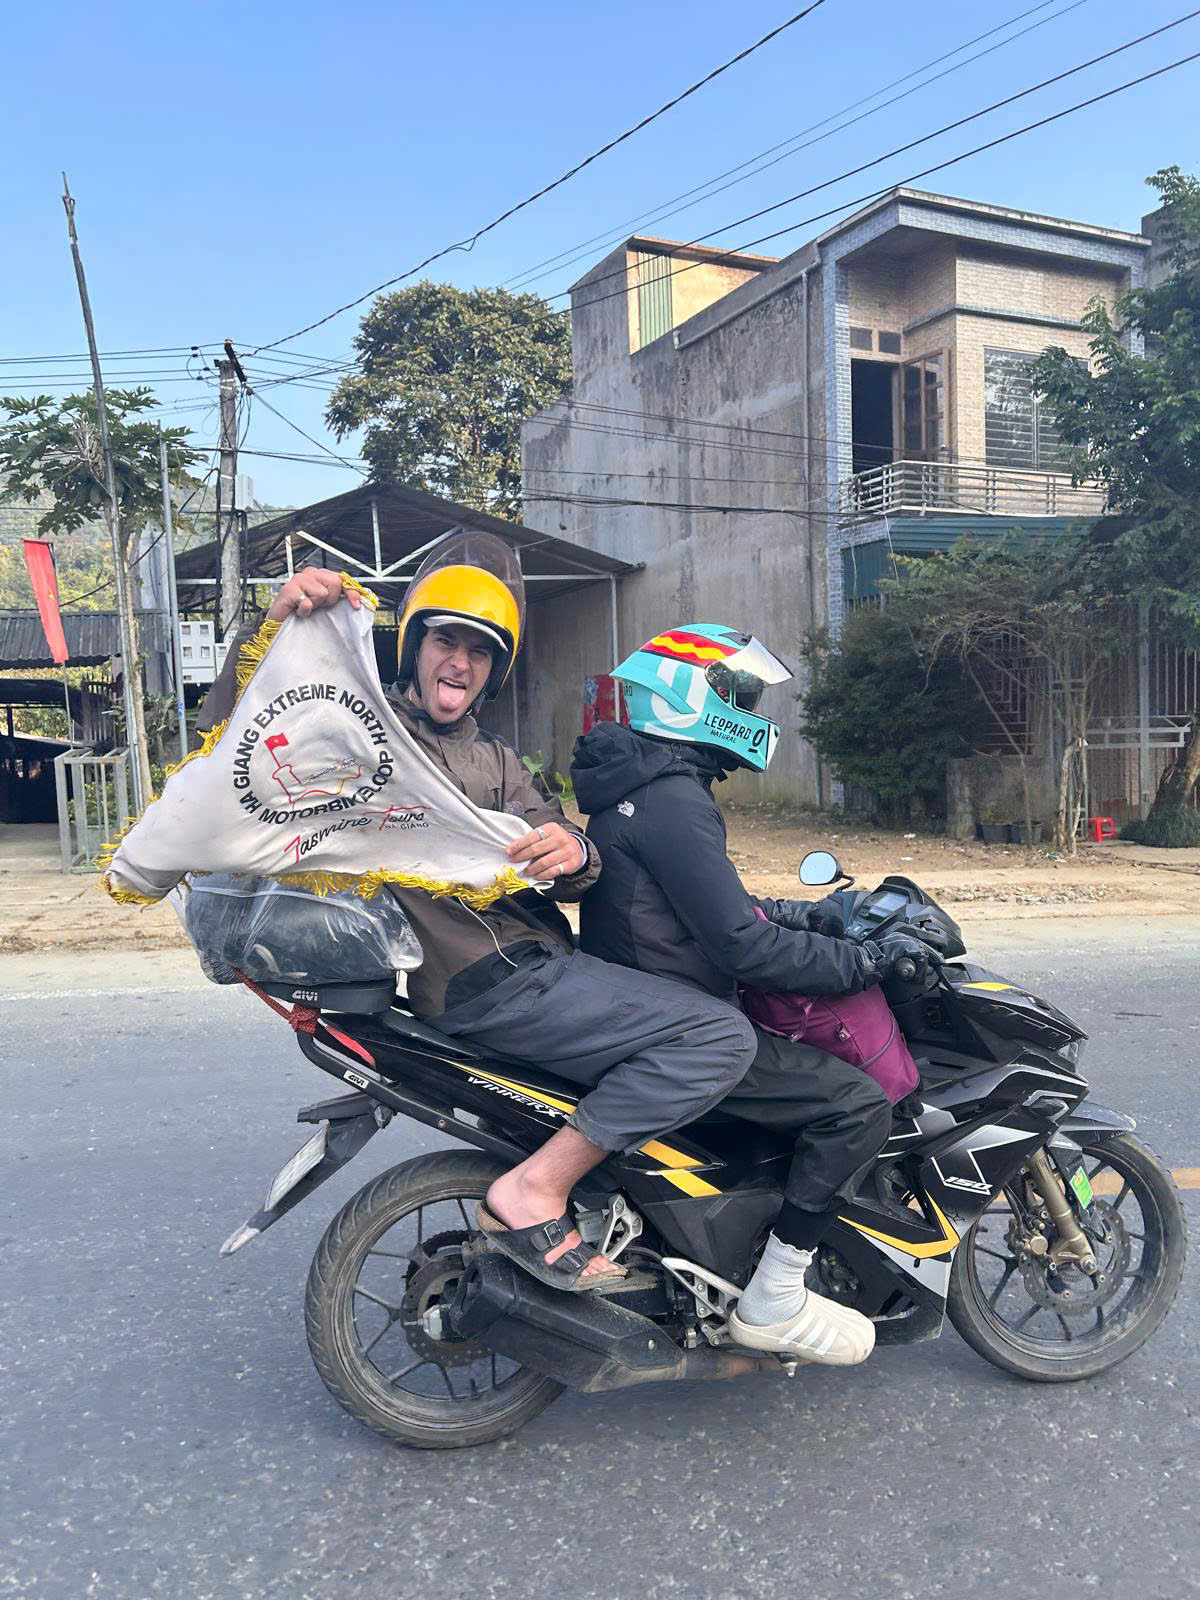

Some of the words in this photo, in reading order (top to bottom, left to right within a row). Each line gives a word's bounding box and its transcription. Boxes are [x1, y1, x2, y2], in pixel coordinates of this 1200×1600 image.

[253, 684, 336, 729] EXTREME
[339, 690, 387, 745] NORTH
[704, 713, 752, 740] LEOPARD
[233, 728, 260, 789] GIANG
[711, 729, 737, 743] NATURAL
[240, 791, 262, 814] HA
[284, 818, 372, 863] Jasmine
[362, 804, 432, 831] Tours
